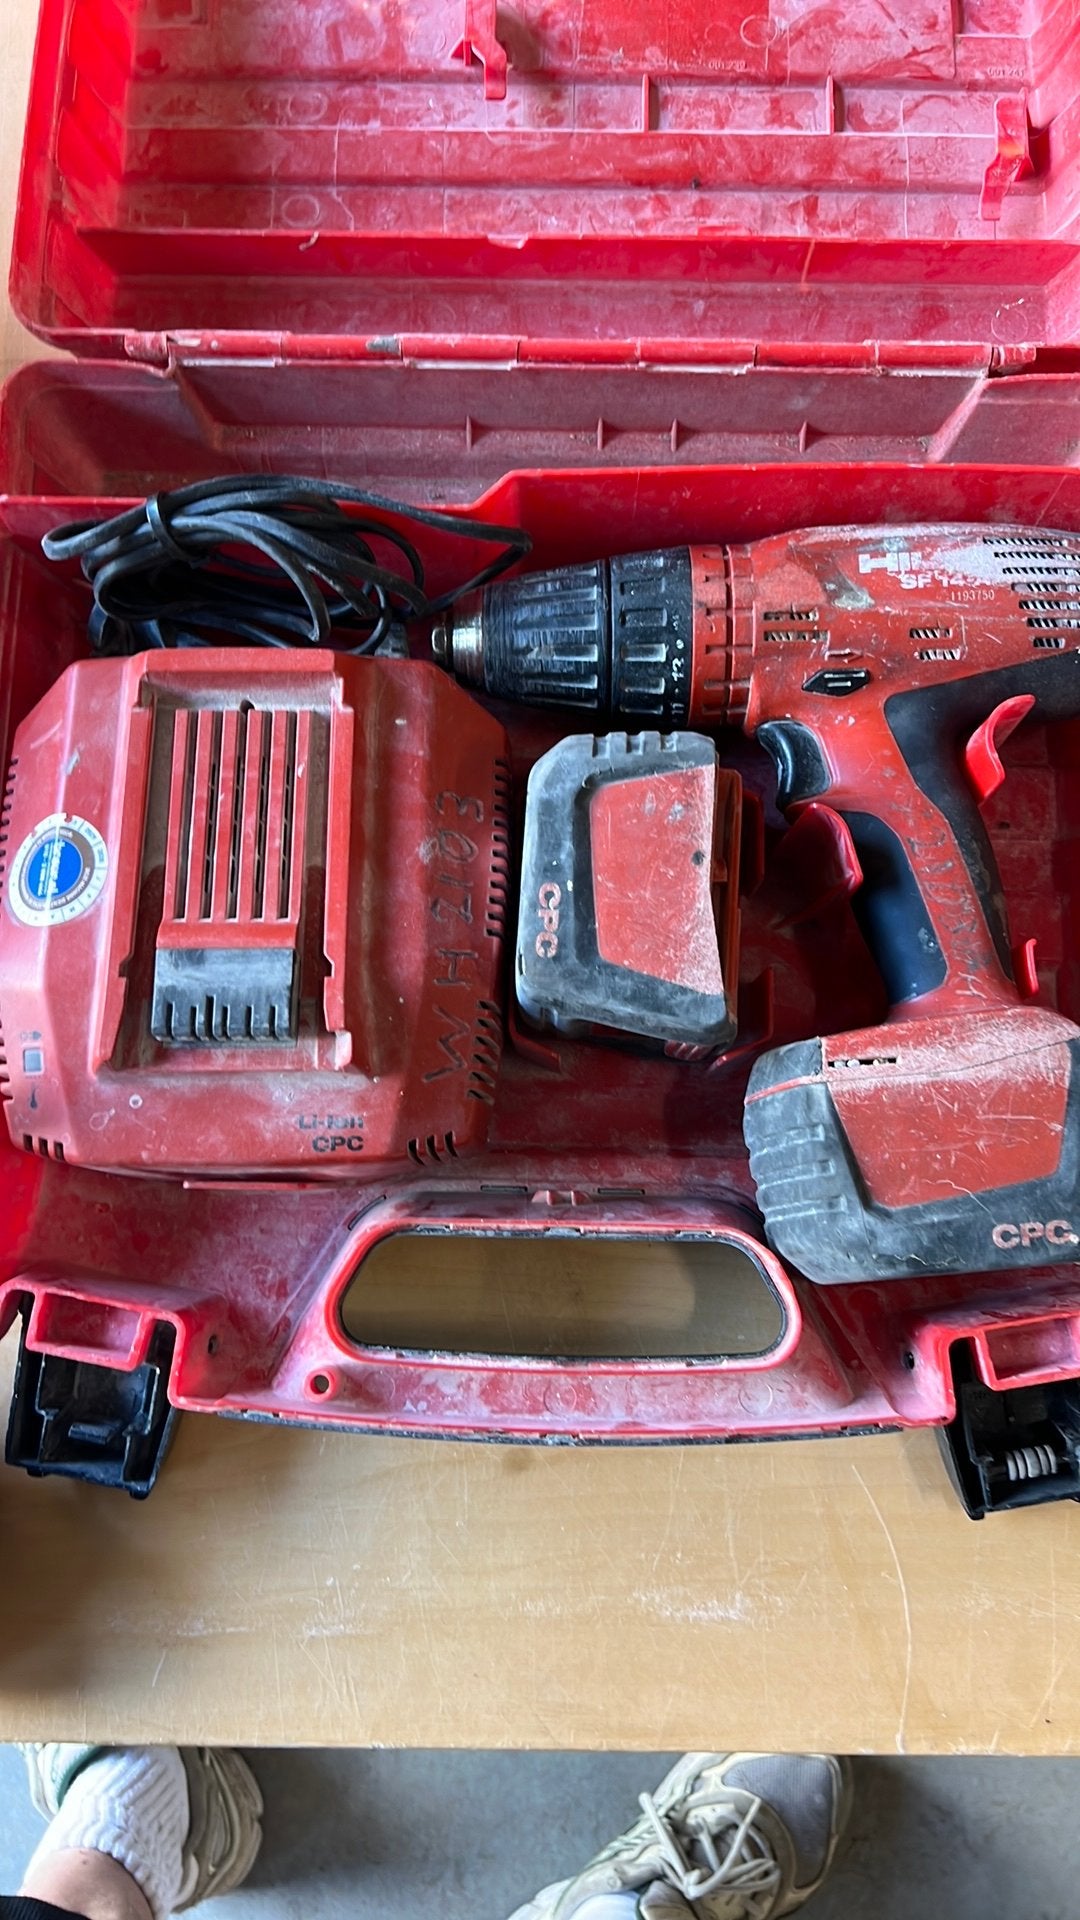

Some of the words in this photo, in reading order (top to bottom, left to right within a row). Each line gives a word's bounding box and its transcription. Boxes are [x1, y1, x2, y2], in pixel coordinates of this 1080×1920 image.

[899, 573, 932, 589] SF
[950, 589, 996, 601] 1193750
[428, 789, 484, 925] 2103
[534, 882, 563, 958] CPC
[312, 1135, 364, 1153] CPC
[991, 1219, 1074, 1249] CPC
